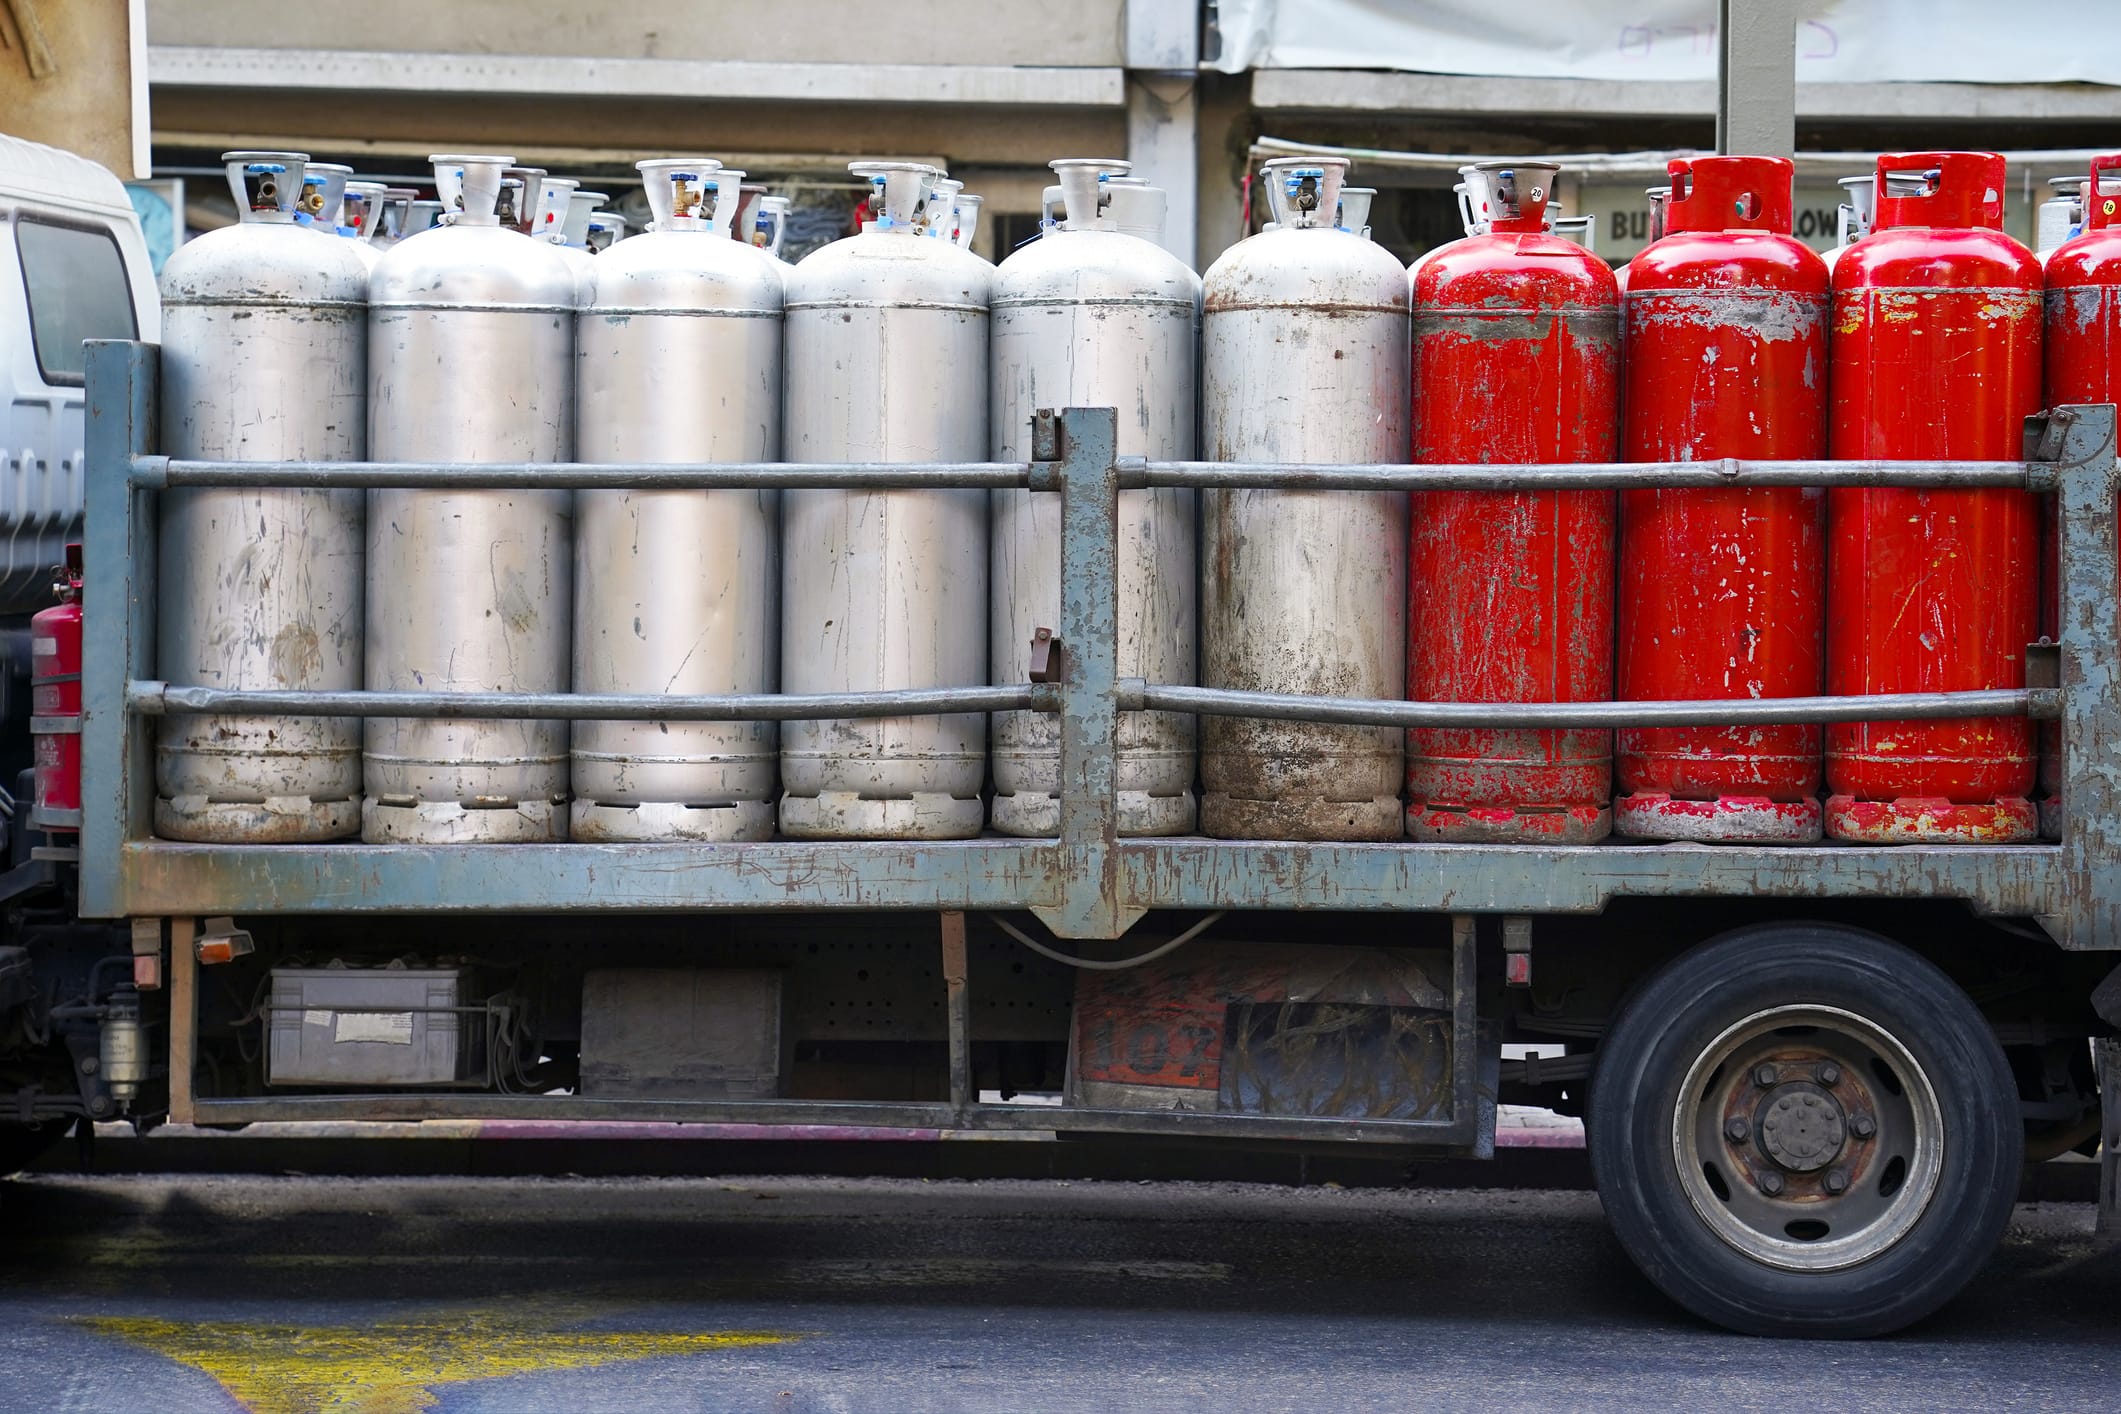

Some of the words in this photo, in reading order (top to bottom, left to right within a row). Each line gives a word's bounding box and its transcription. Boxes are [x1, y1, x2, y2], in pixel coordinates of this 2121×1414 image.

[1532, 188, 1542, 198] 20
[2104, 202, 2114, 213] 18
[1611, 211, 1650, 241] BU
